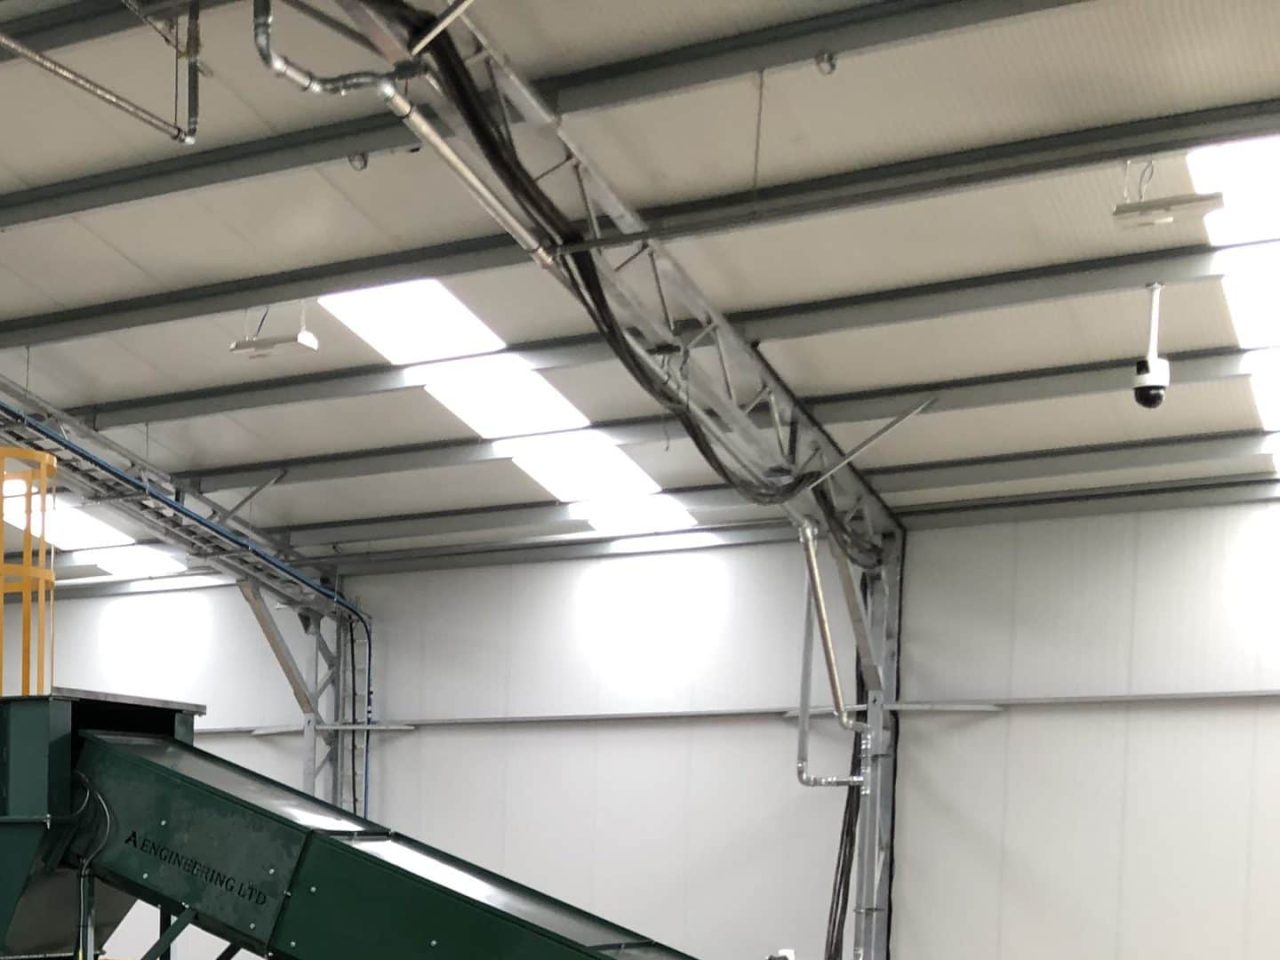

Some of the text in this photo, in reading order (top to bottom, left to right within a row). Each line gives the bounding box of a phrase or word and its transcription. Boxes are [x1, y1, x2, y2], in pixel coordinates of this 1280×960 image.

[124, 831, 267, 906] A ENGINEERING LTD
